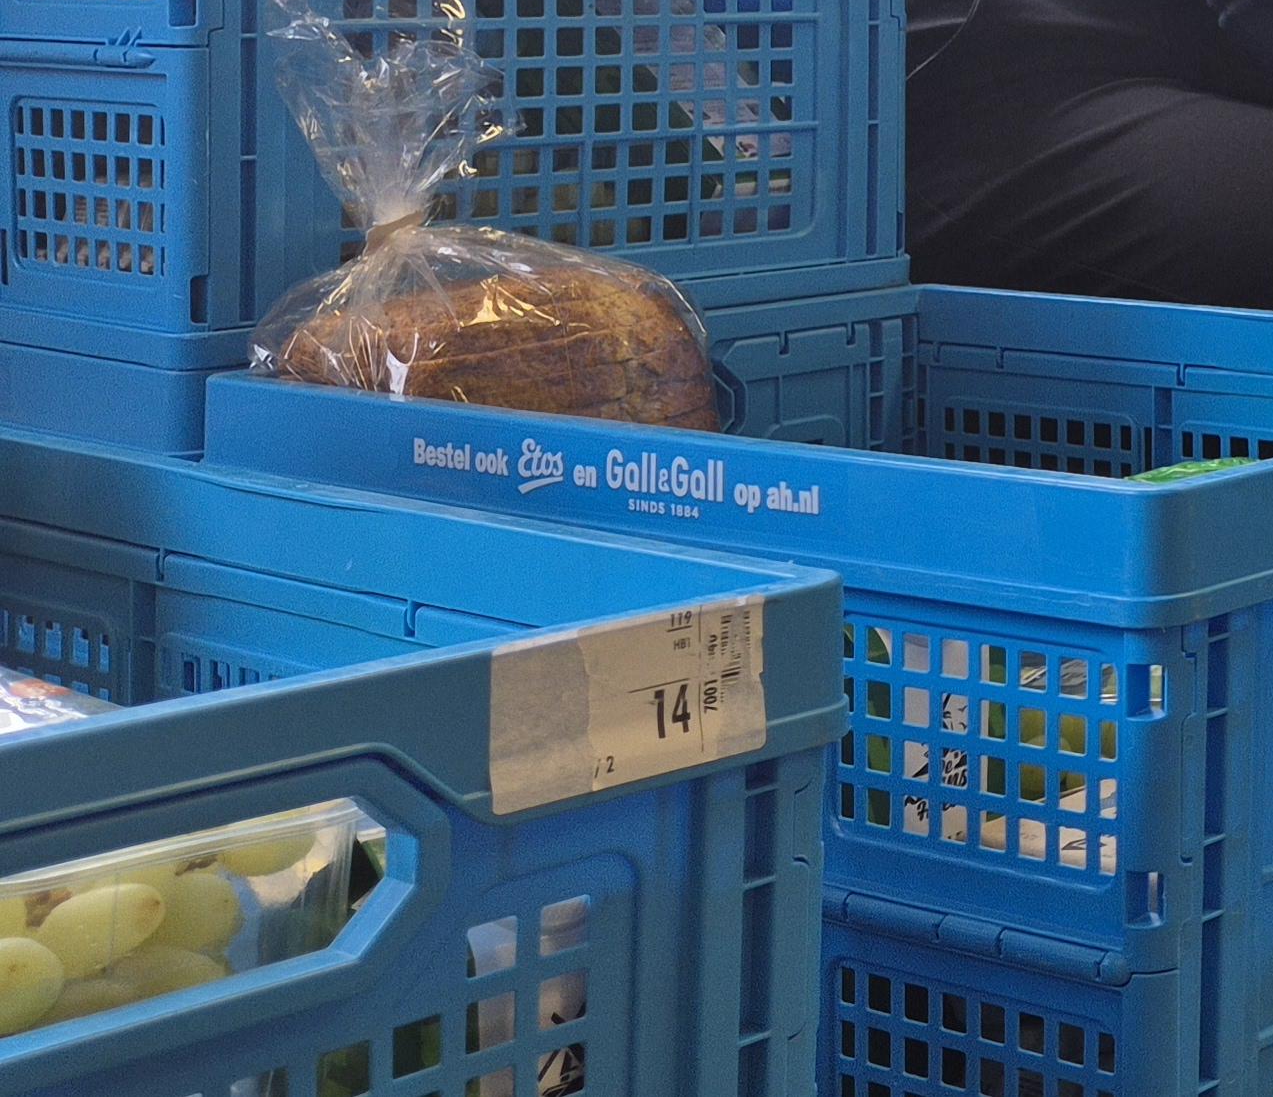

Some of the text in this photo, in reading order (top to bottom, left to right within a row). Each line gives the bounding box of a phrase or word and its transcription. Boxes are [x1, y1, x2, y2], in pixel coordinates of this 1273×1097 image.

[413, 437, 820, 515] Bestel ook Etos en Gall&Gall op ah.nl
[628, 498, 700, 519] SINDS 1884
[669, 610, 693, 628] 119
[653, 683, 691, 739] 14
